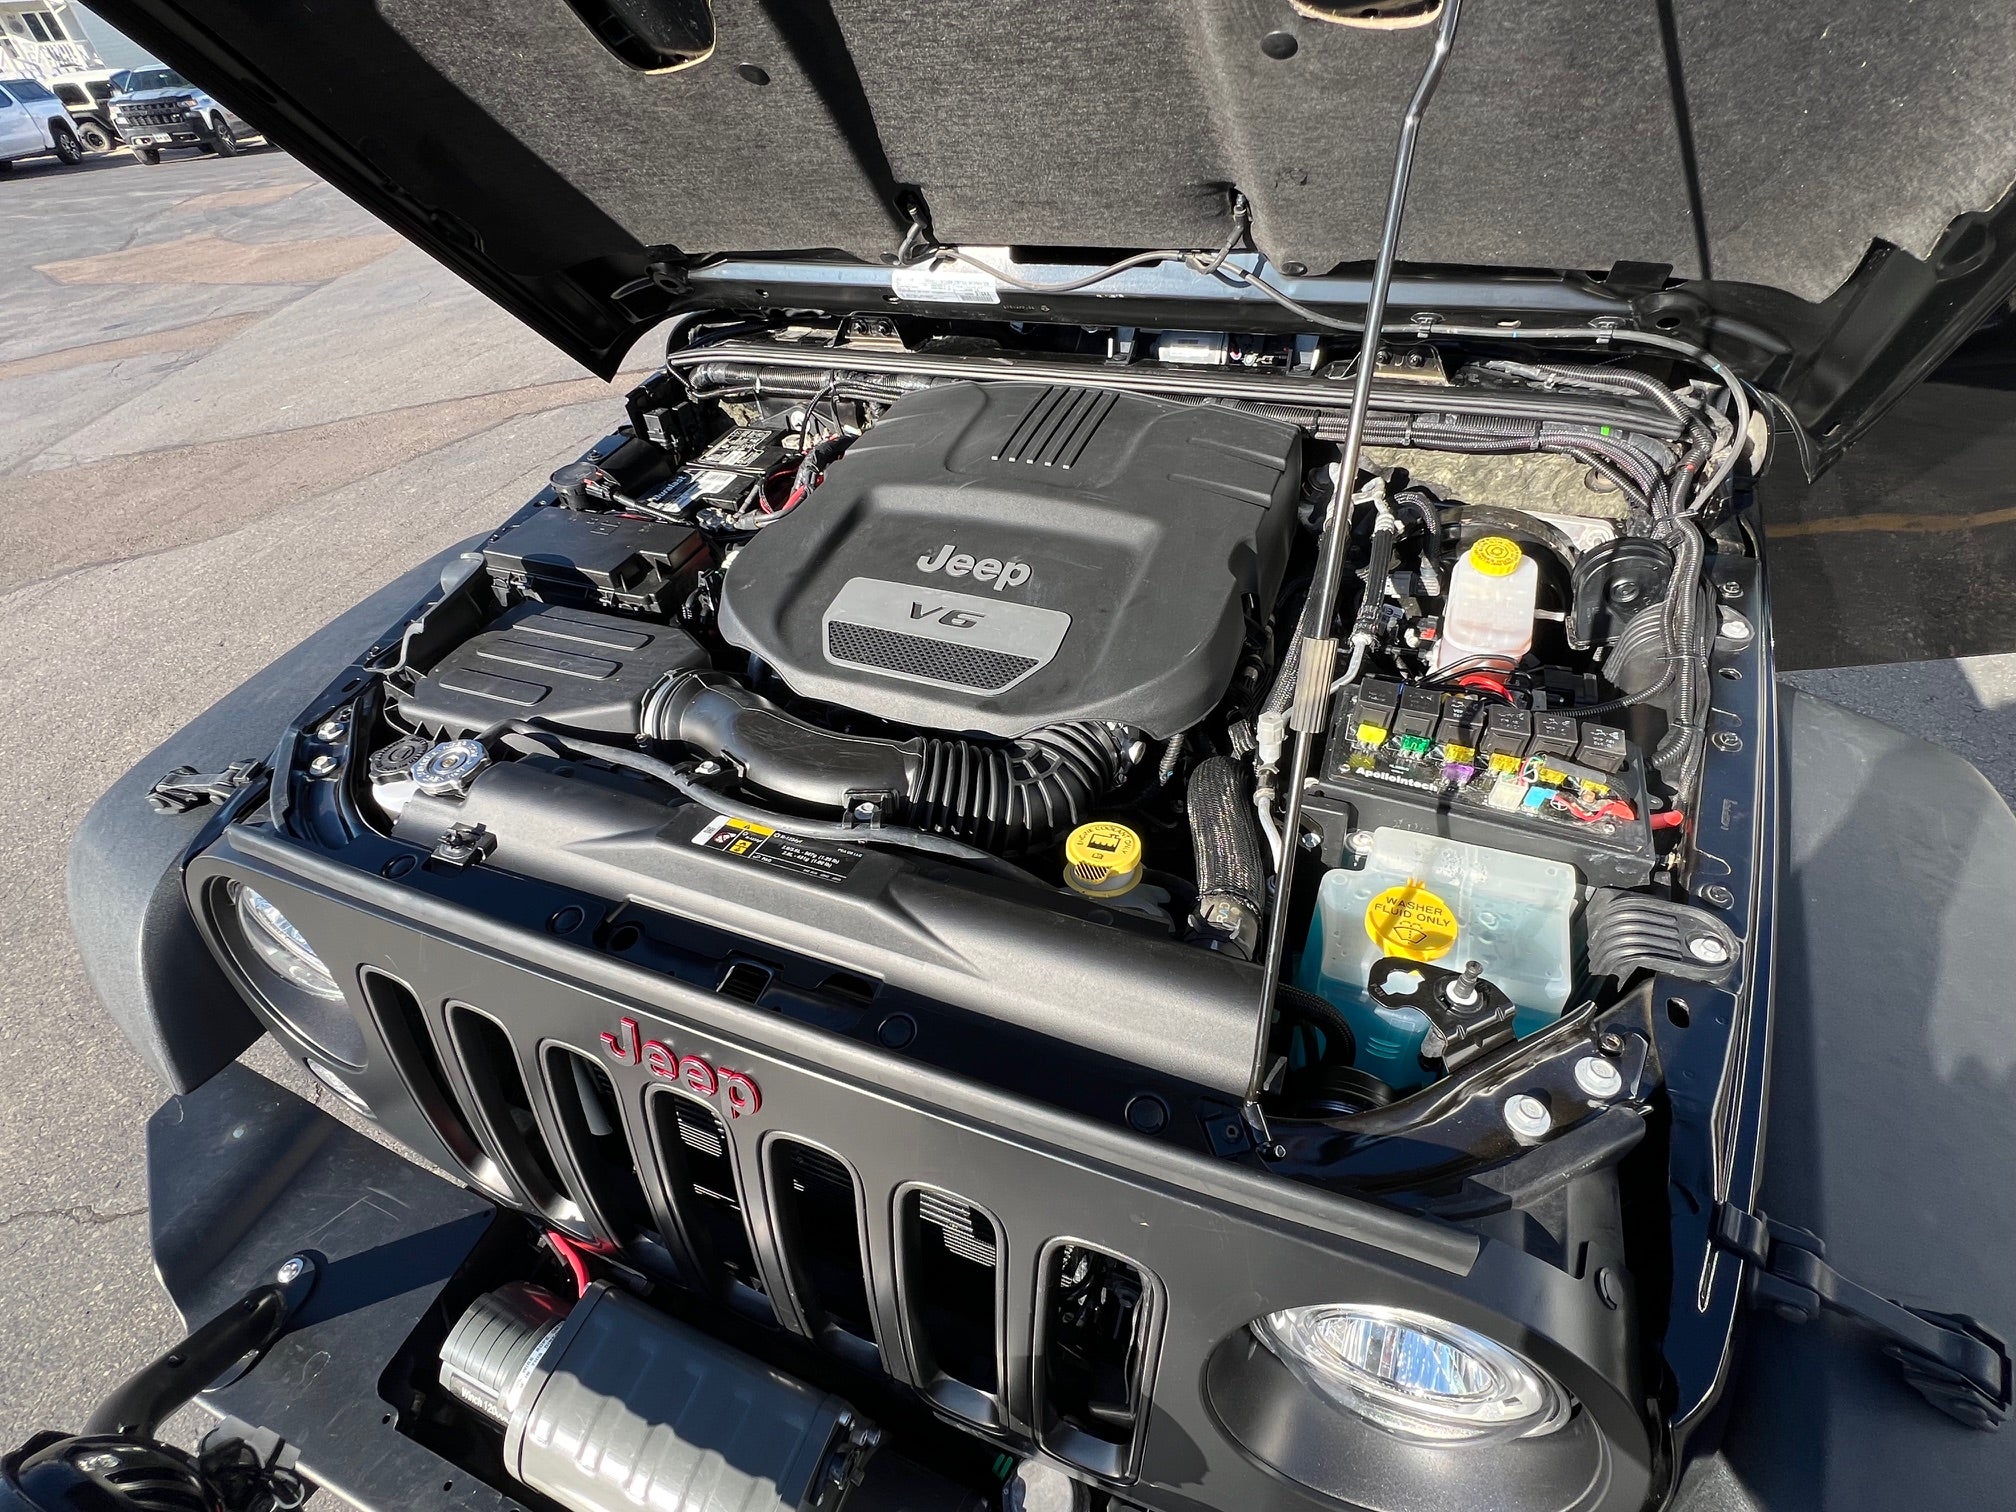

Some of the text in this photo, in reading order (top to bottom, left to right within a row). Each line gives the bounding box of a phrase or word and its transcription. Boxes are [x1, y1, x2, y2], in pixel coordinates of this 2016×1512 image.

[652, 475, 687, 501] Duralast
[916, 544, 1033, 591] Jeep
[909, 601, 986, 628] V6
[1374, 903, 1451, 927] FLUID ONLY
[1386, 896, 1443, 916] WASHER
[600, 1017, 763, 1119] Jeep
[461, 1386, 482, 1408] Winch
